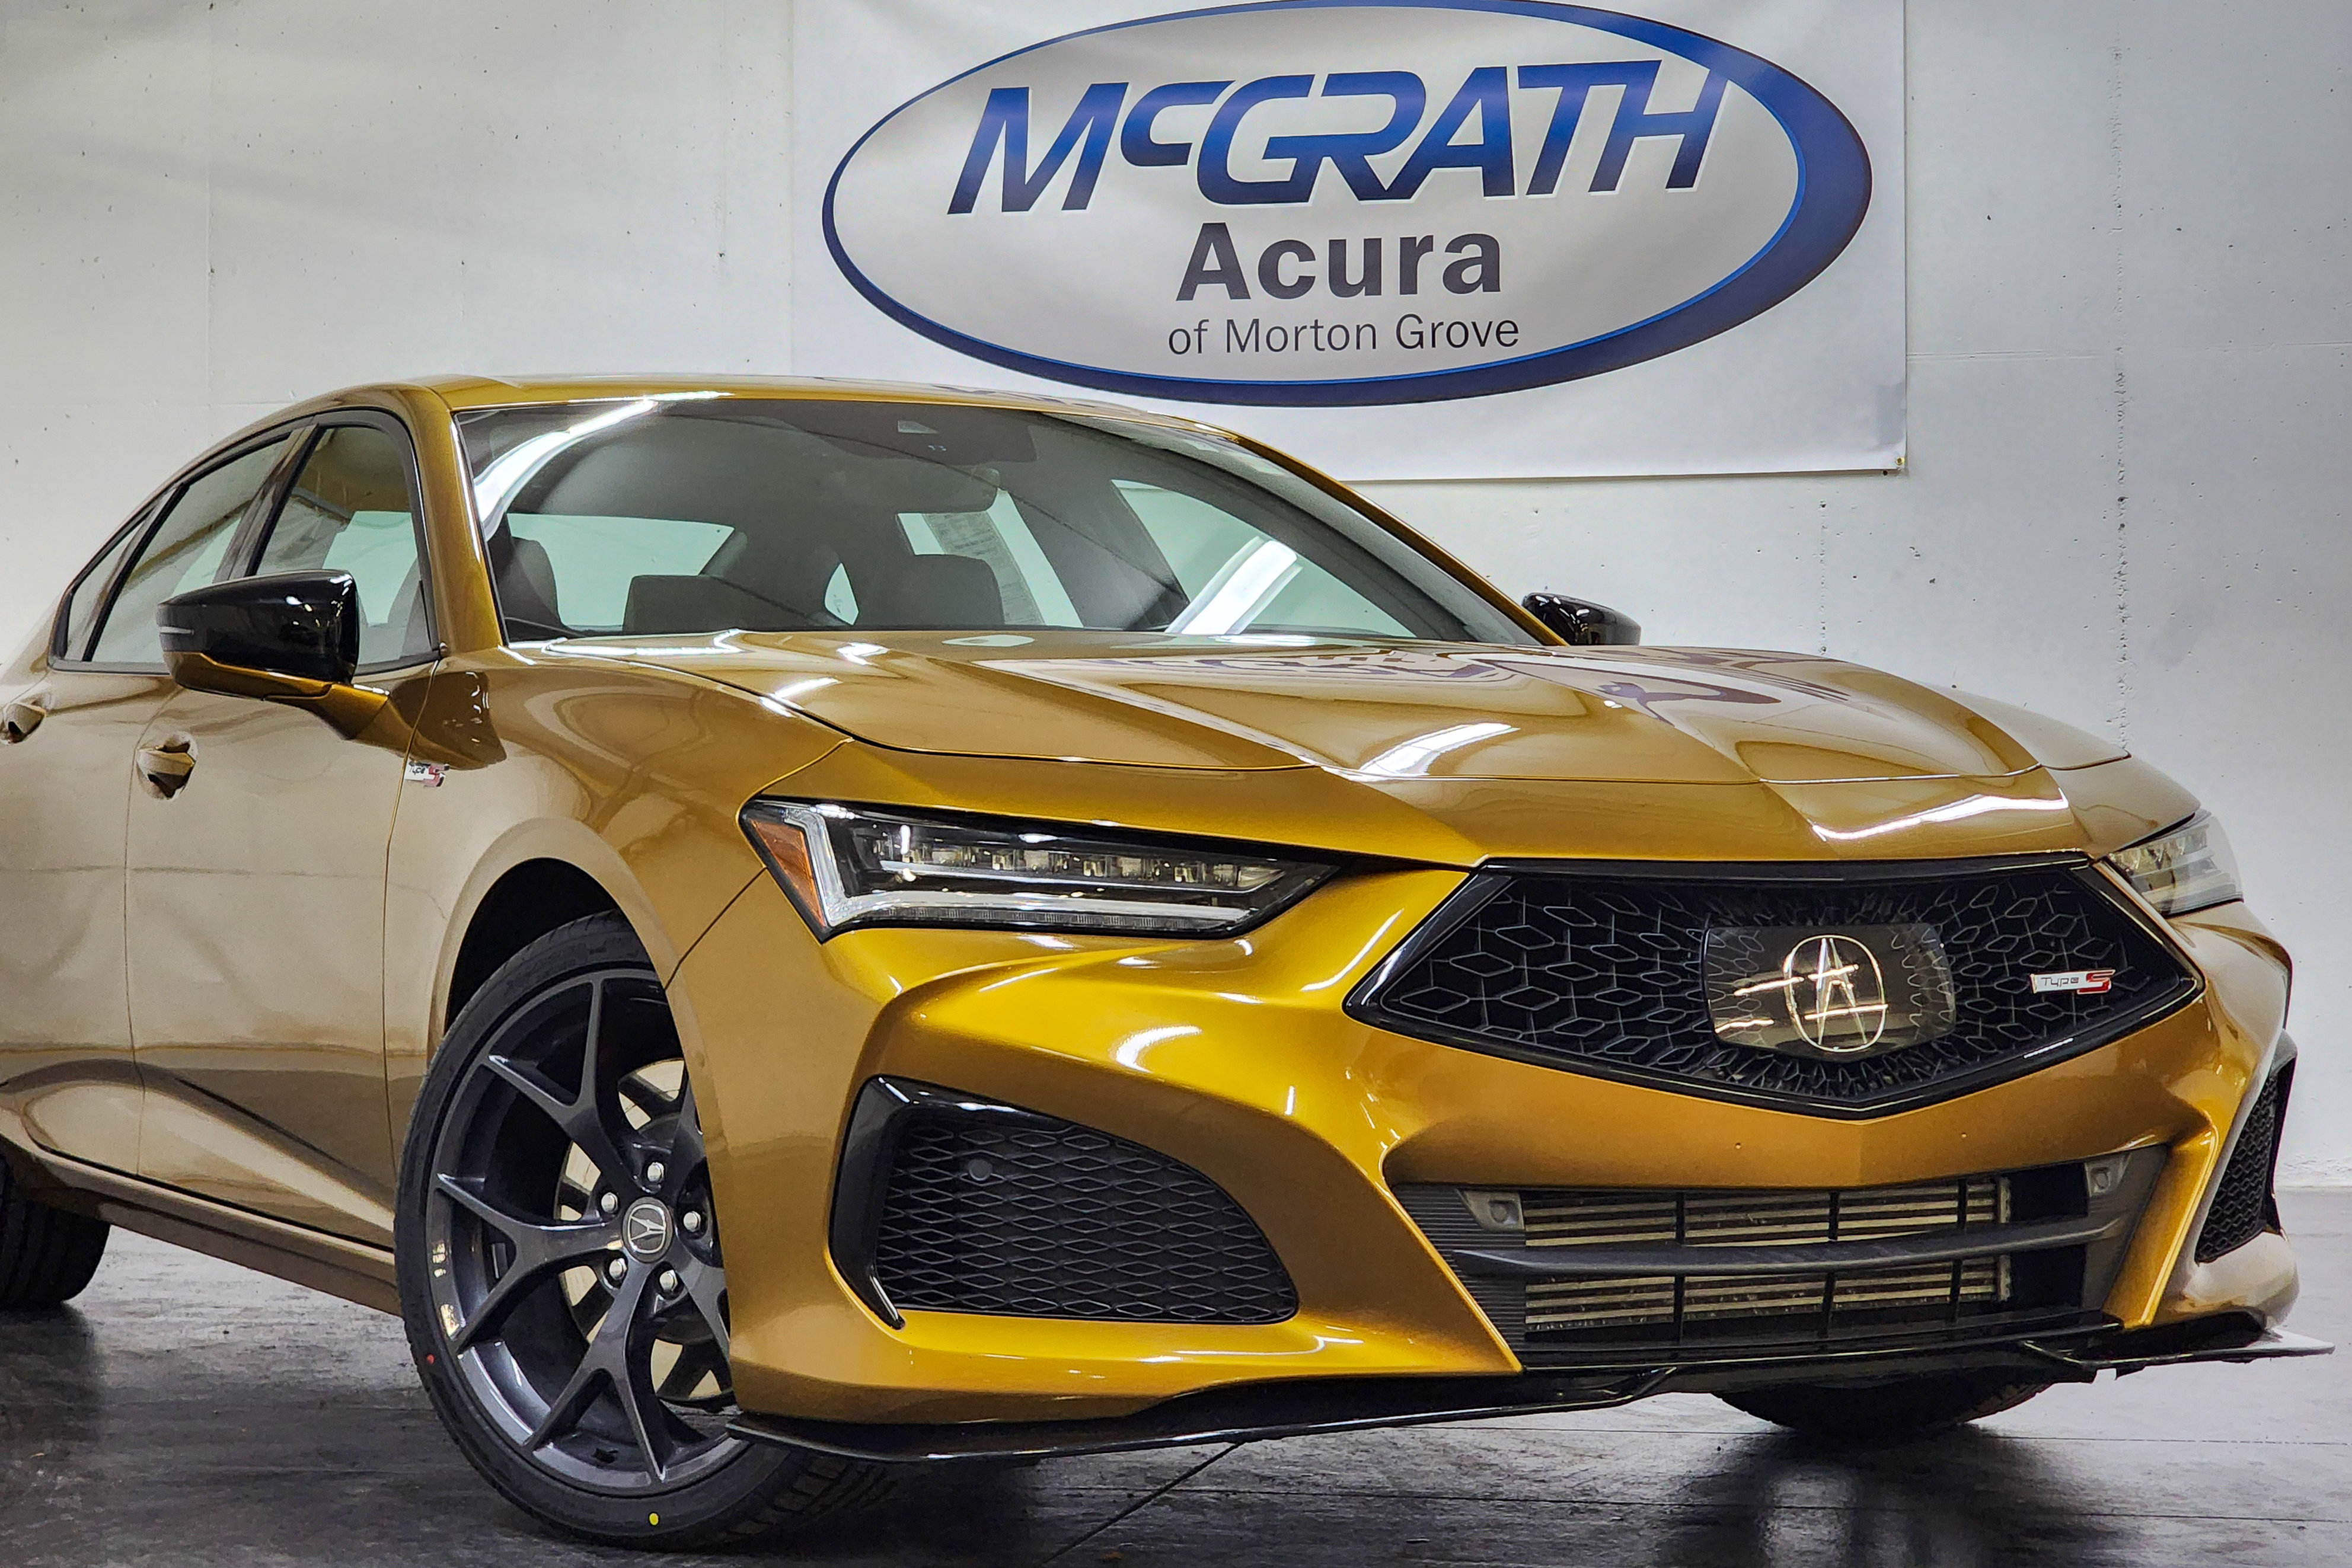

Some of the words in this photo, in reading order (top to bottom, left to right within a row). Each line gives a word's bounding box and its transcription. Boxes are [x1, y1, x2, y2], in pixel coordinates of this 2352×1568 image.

[1176, 222, 1501, 301] Acura
[1169, 318, 1209, 355] of
[1226, 318, 1377, 353] Morton
[1396, 314, 1519, 350] Grove
[2076, 969, 2116, 995] S
